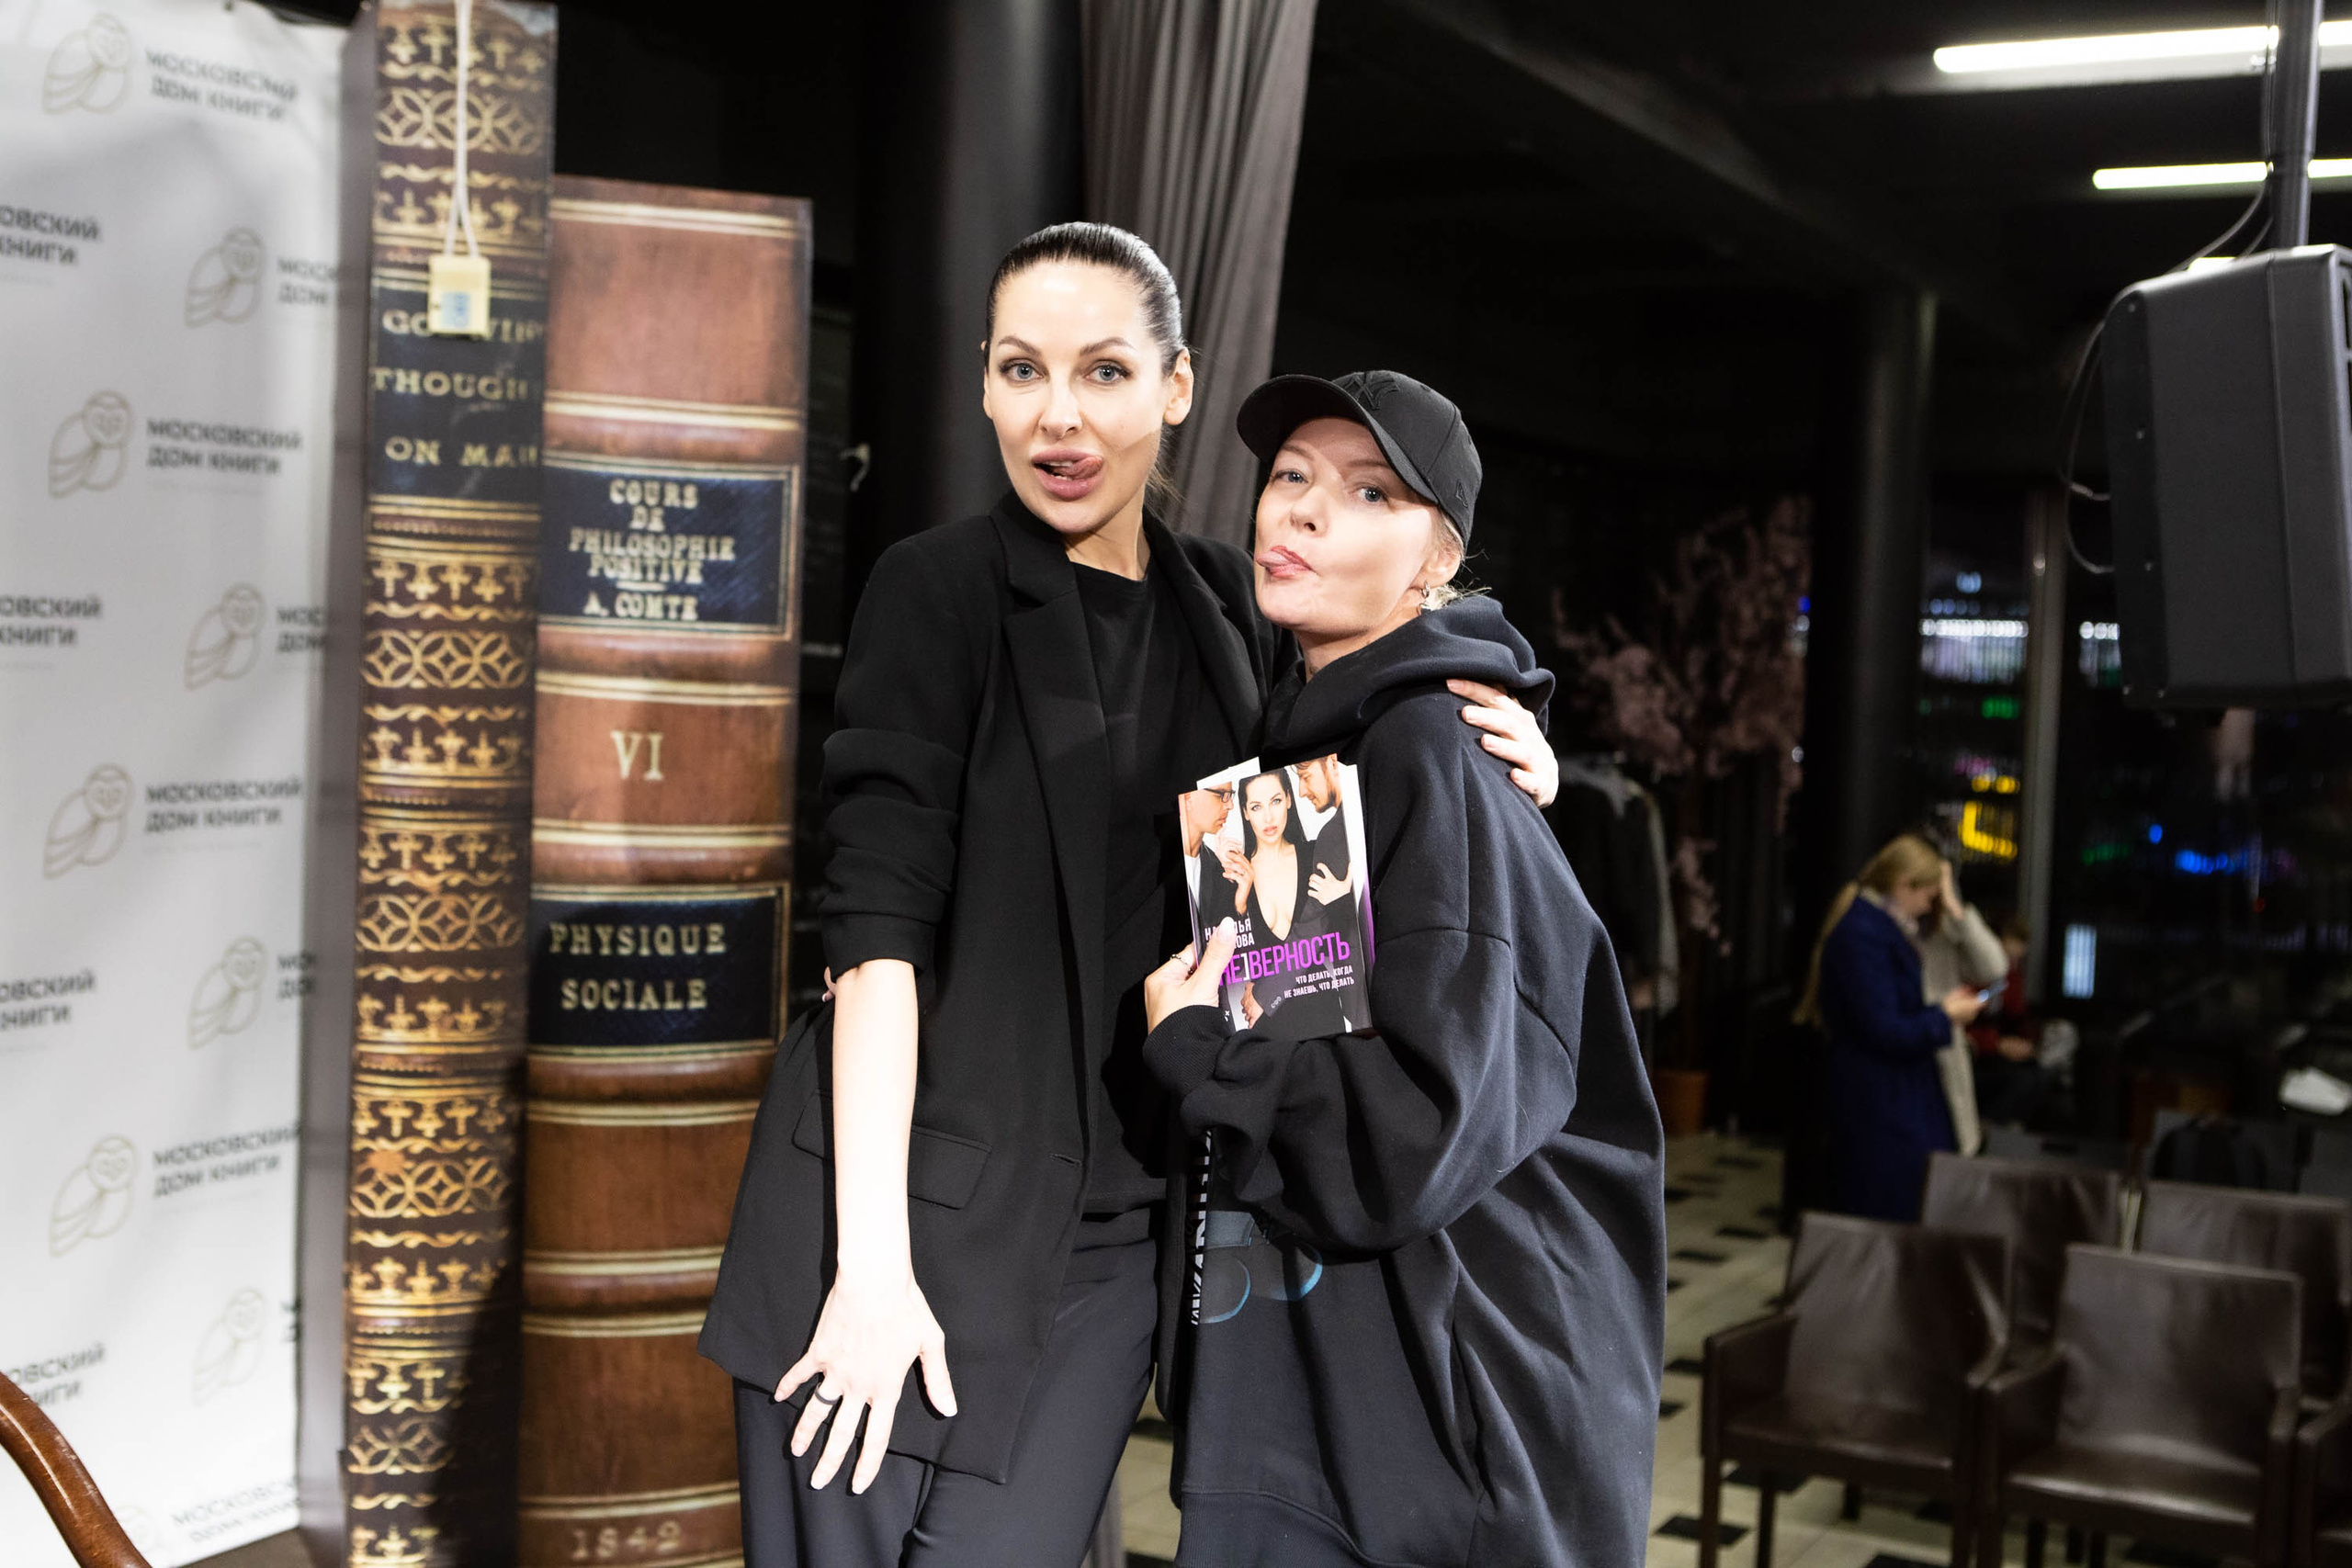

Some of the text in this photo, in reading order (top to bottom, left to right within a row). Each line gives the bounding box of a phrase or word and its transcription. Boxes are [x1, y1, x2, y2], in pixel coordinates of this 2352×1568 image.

[145, 48, 299, 102] МОСКОВСКИЙ
[151, 73, 286, 123] ДОМ КНИГИ
[147, 418, 301, 450] МОСКОВСКИЙ
[148, 447, 280, 475] ДОМ КНИГИ
[385, 435, 441, 466] ON
[609, 479, 698, 509] COURS
[628, 505, 665, 532] DE
[569, 527, 736, 561] PHILOSOPHIE
[587, 553, 704, 584] POSITIVE
[582, 592, 699, 621] A. COMTE
[610, 730, 664, 781] VI
[146, 778, 302, 804] МОСКОВСКИЙ
[147, 807, 280, 834] ДОМ КНИГИ
[548, 921, 726, 956] PHYSIQUE
[1283, 976, 1355, 998] НЕ ЗНАЕШЬ, ЧТО ДЕЛАТЬ
[1295, 975, 1307, 985] ЧТО
[1333, 964, 1353, 976] КОГДА
[560, 978, 707, 1010] SOCIALE
[153, 1154, 280, 1198] ДОМ КНИГИ
